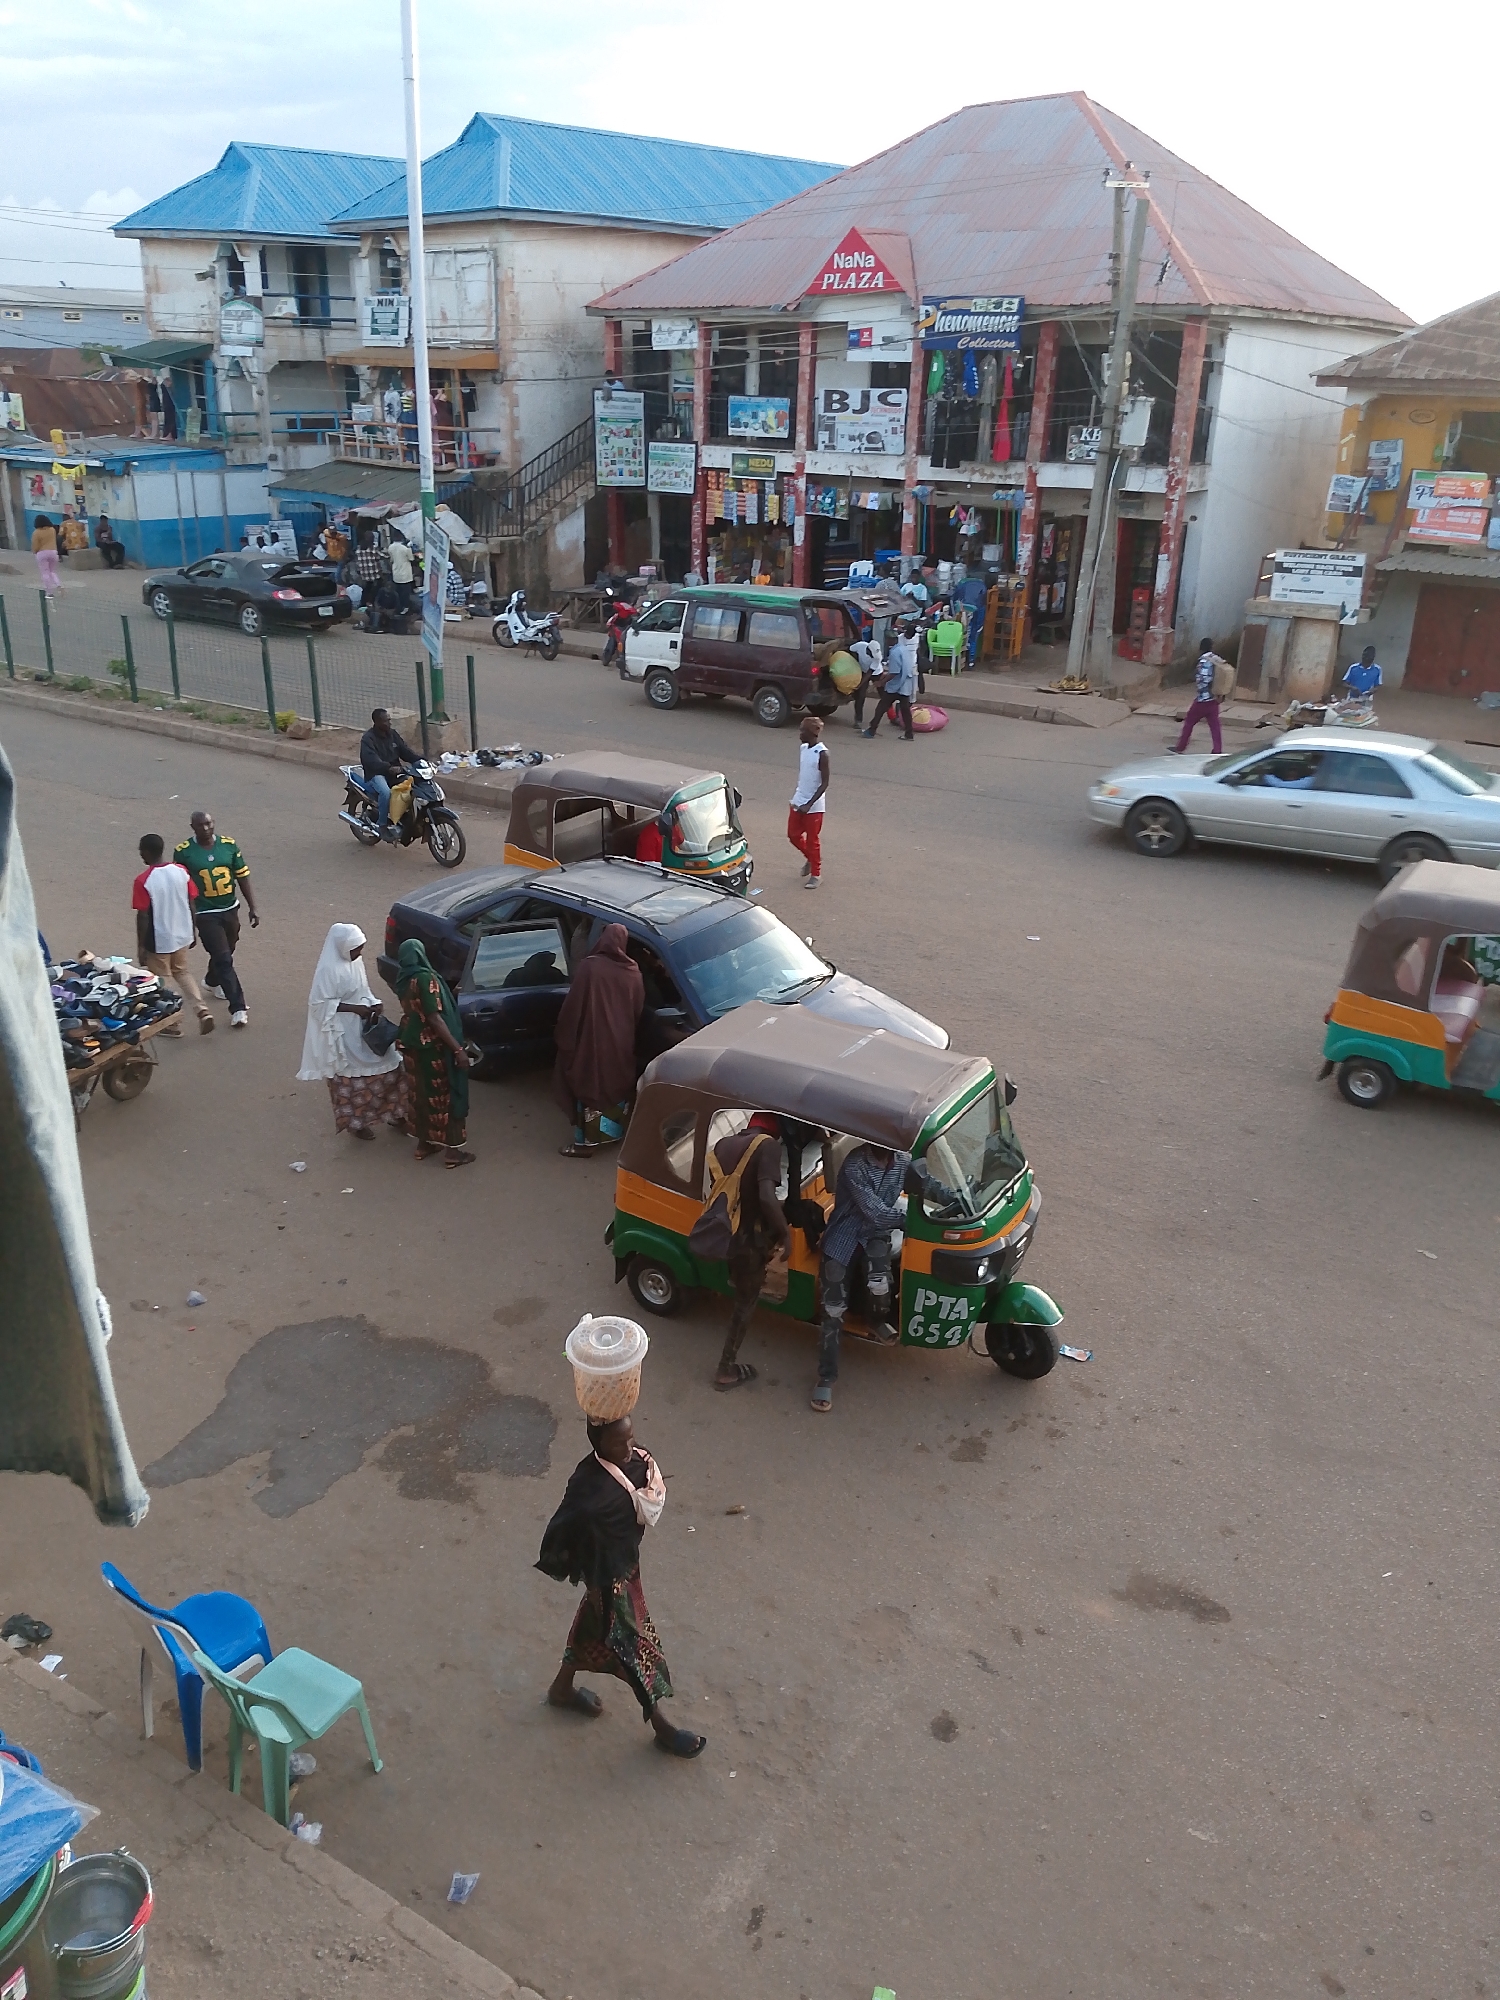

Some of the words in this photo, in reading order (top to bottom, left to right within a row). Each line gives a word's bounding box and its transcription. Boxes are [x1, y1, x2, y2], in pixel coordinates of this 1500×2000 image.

[833, 252, 876, 269] NaNa
[821, 271, 885, 290] PLAZA
[377, 298, 395, 307] NIN
[957, 337, 1016, 349] Collection
[823, 389, 903, 415] BJC
[749, 458, 774, 468] NEDU
[1329, 554, 1357, 562] GRACE
[199, 866, 233, 897] 12
